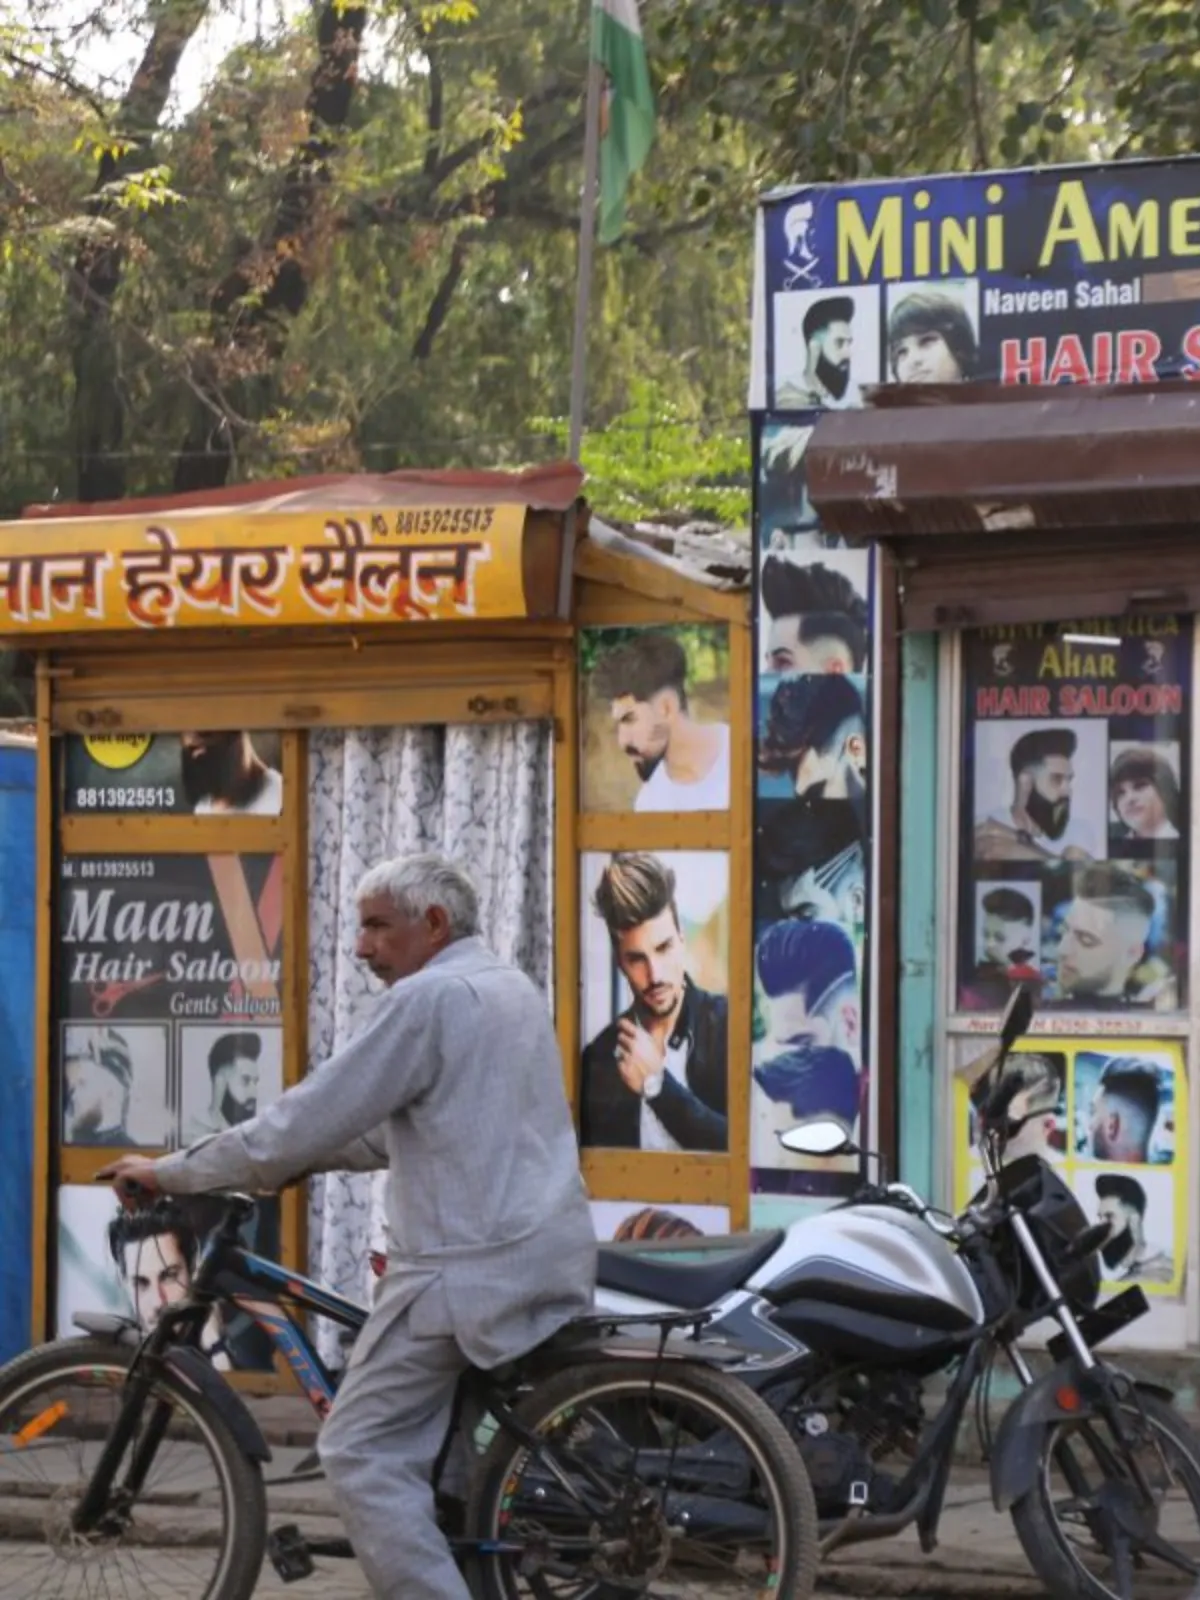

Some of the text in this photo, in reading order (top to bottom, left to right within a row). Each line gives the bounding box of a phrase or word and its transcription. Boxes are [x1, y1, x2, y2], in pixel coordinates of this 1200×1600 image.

[984, 276, 1141, 316] Naveen Sahal
[1001, 330, 1160, 386] HAIR
[396, 507, 496, 536] 8813925513
[121, 524, 292, 628] हेयर
[977, 684, 1182, 715] HAIR SALOON
[77, 787, 175, 807] 8813925513
[81, 861, 155, 878] 8813925513
[61, 888, 214, 943] Maan
[69, 951, 281, 983] Hair Saloon
[170, 991, 281, 1015] Gents Saloon
